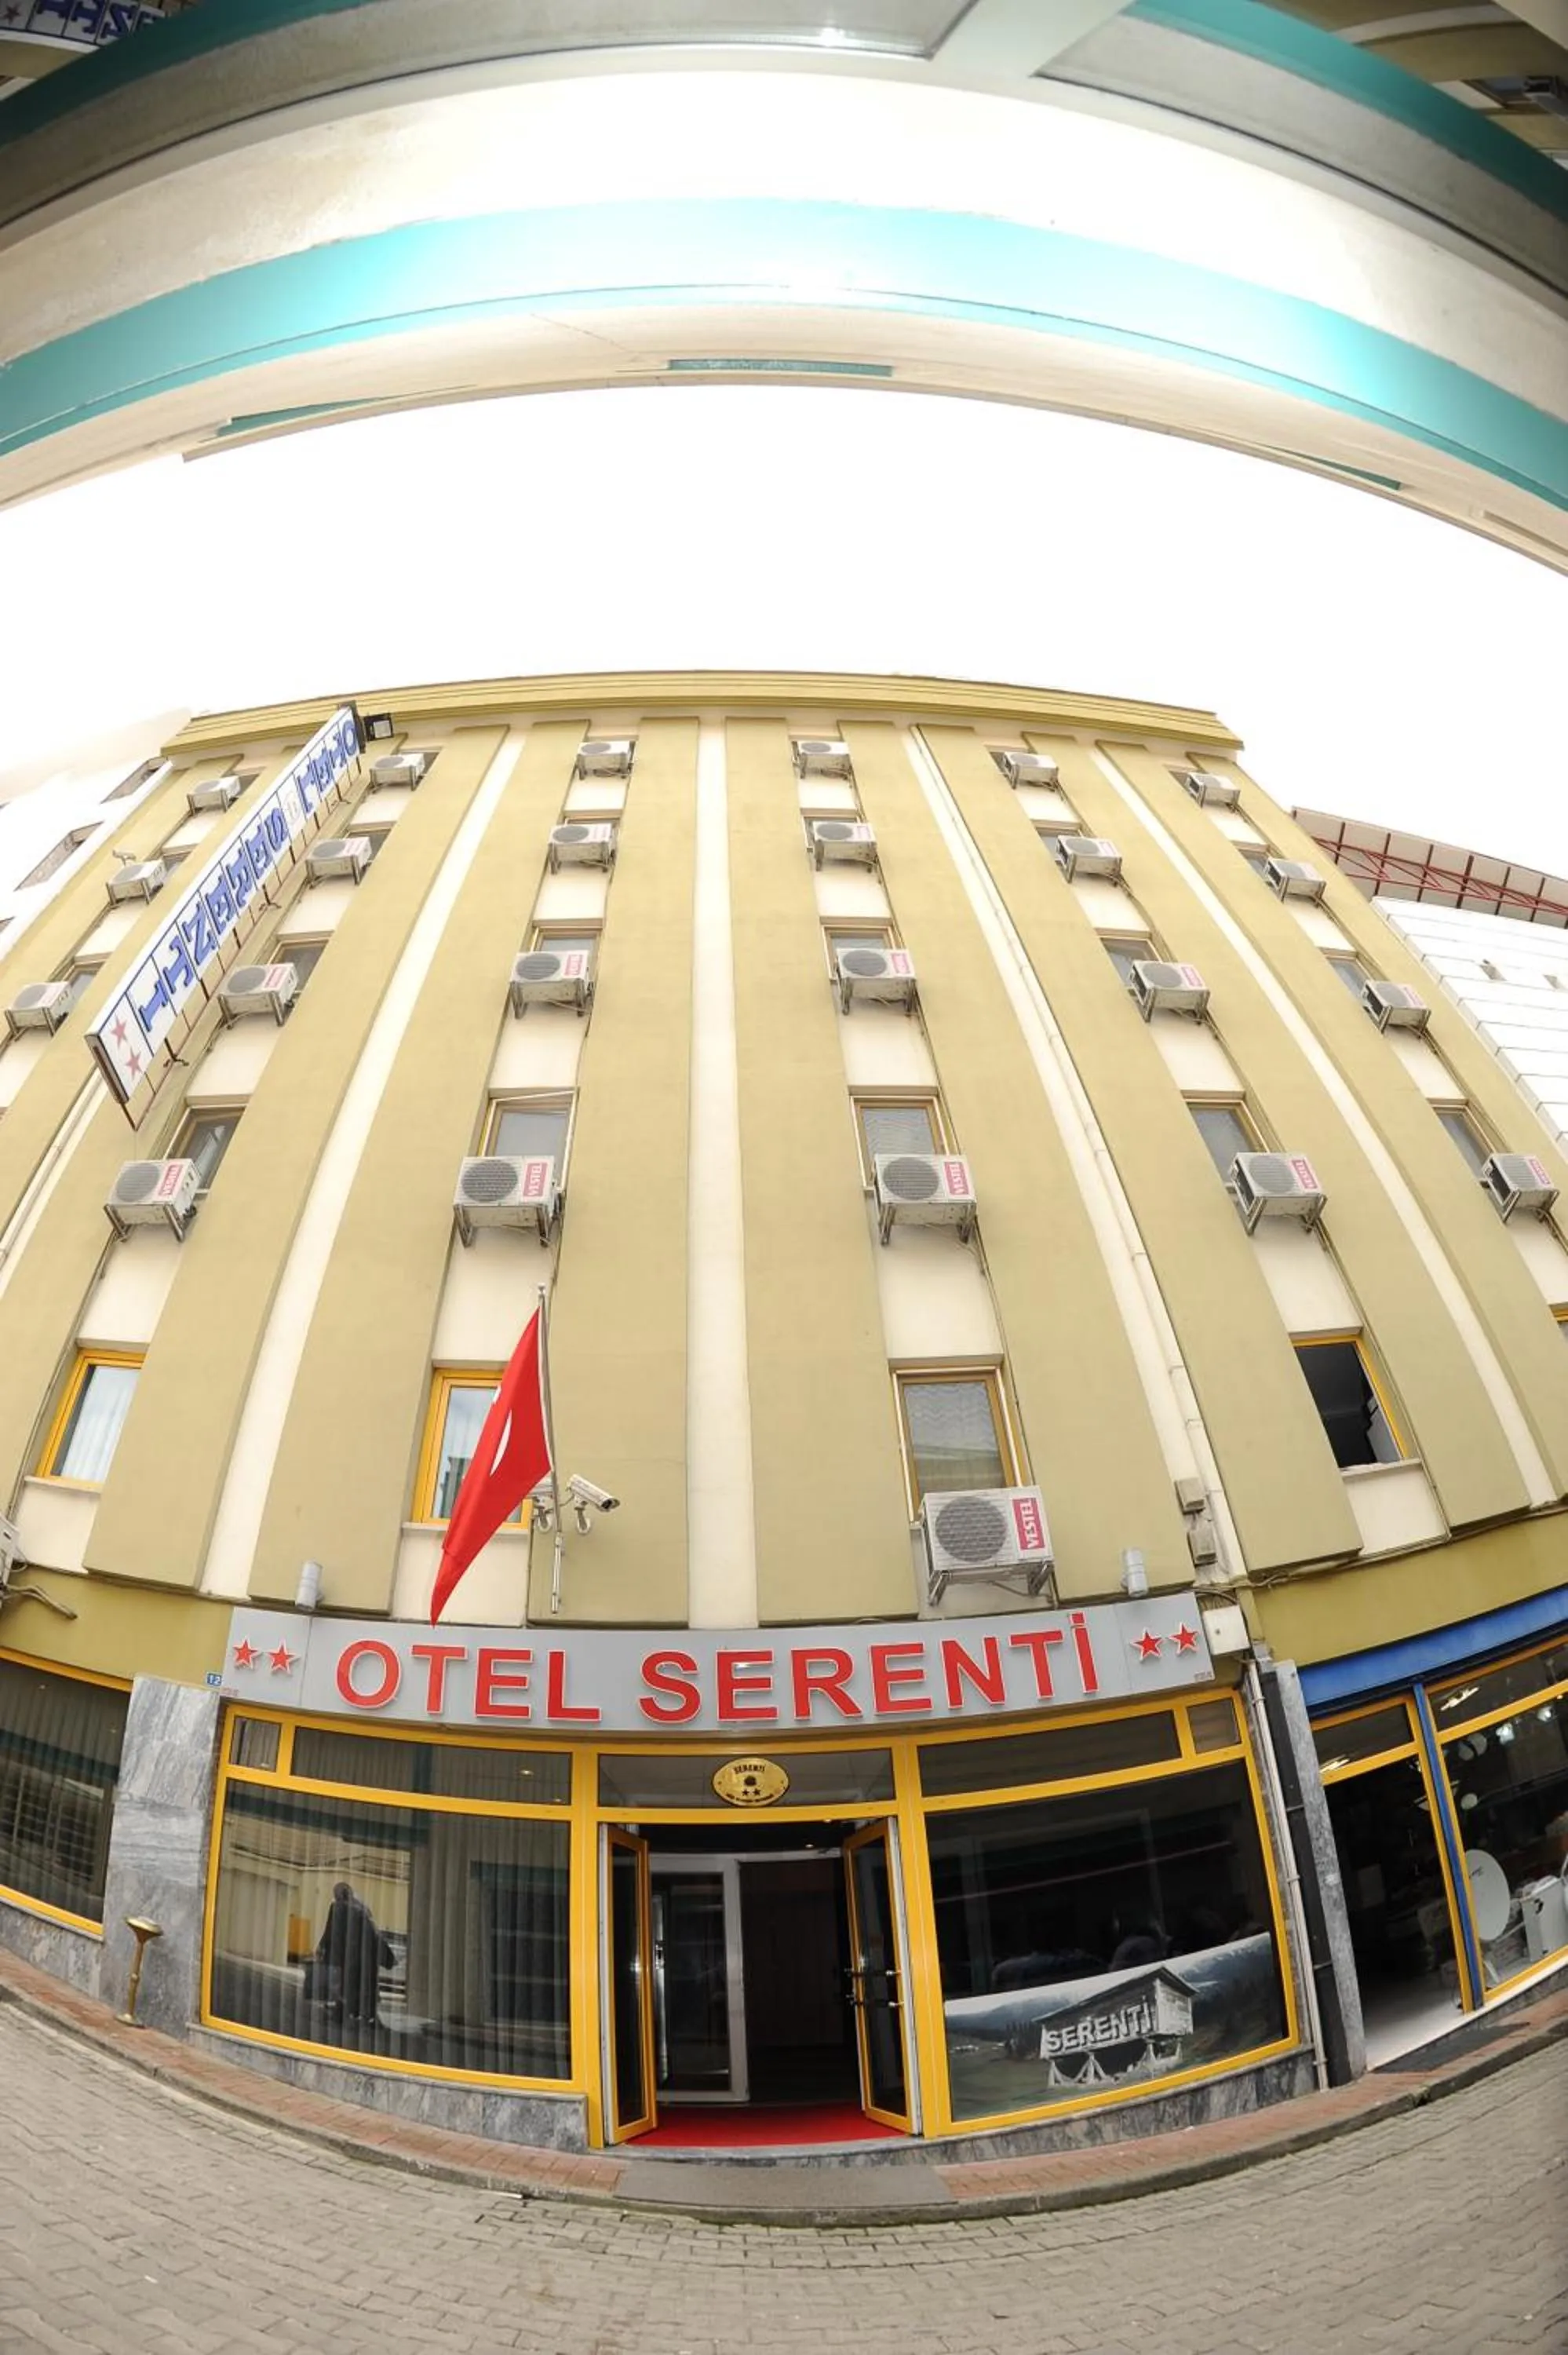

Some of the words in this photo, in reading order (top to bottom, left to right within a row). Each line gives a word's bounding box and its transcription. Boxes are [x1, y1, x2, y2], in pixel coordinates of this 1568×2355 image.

[297, 719, 359, 813] OTEL
[137, 807, 288, 1032] SERENTI
[1019, 1498, 1041, 1549] VESTEL
[210, 1674, 221, 1685] 12
[334, 1638, 602, 1722] OTEL
[638, 1611, 1099, 1723] SERENTİ
